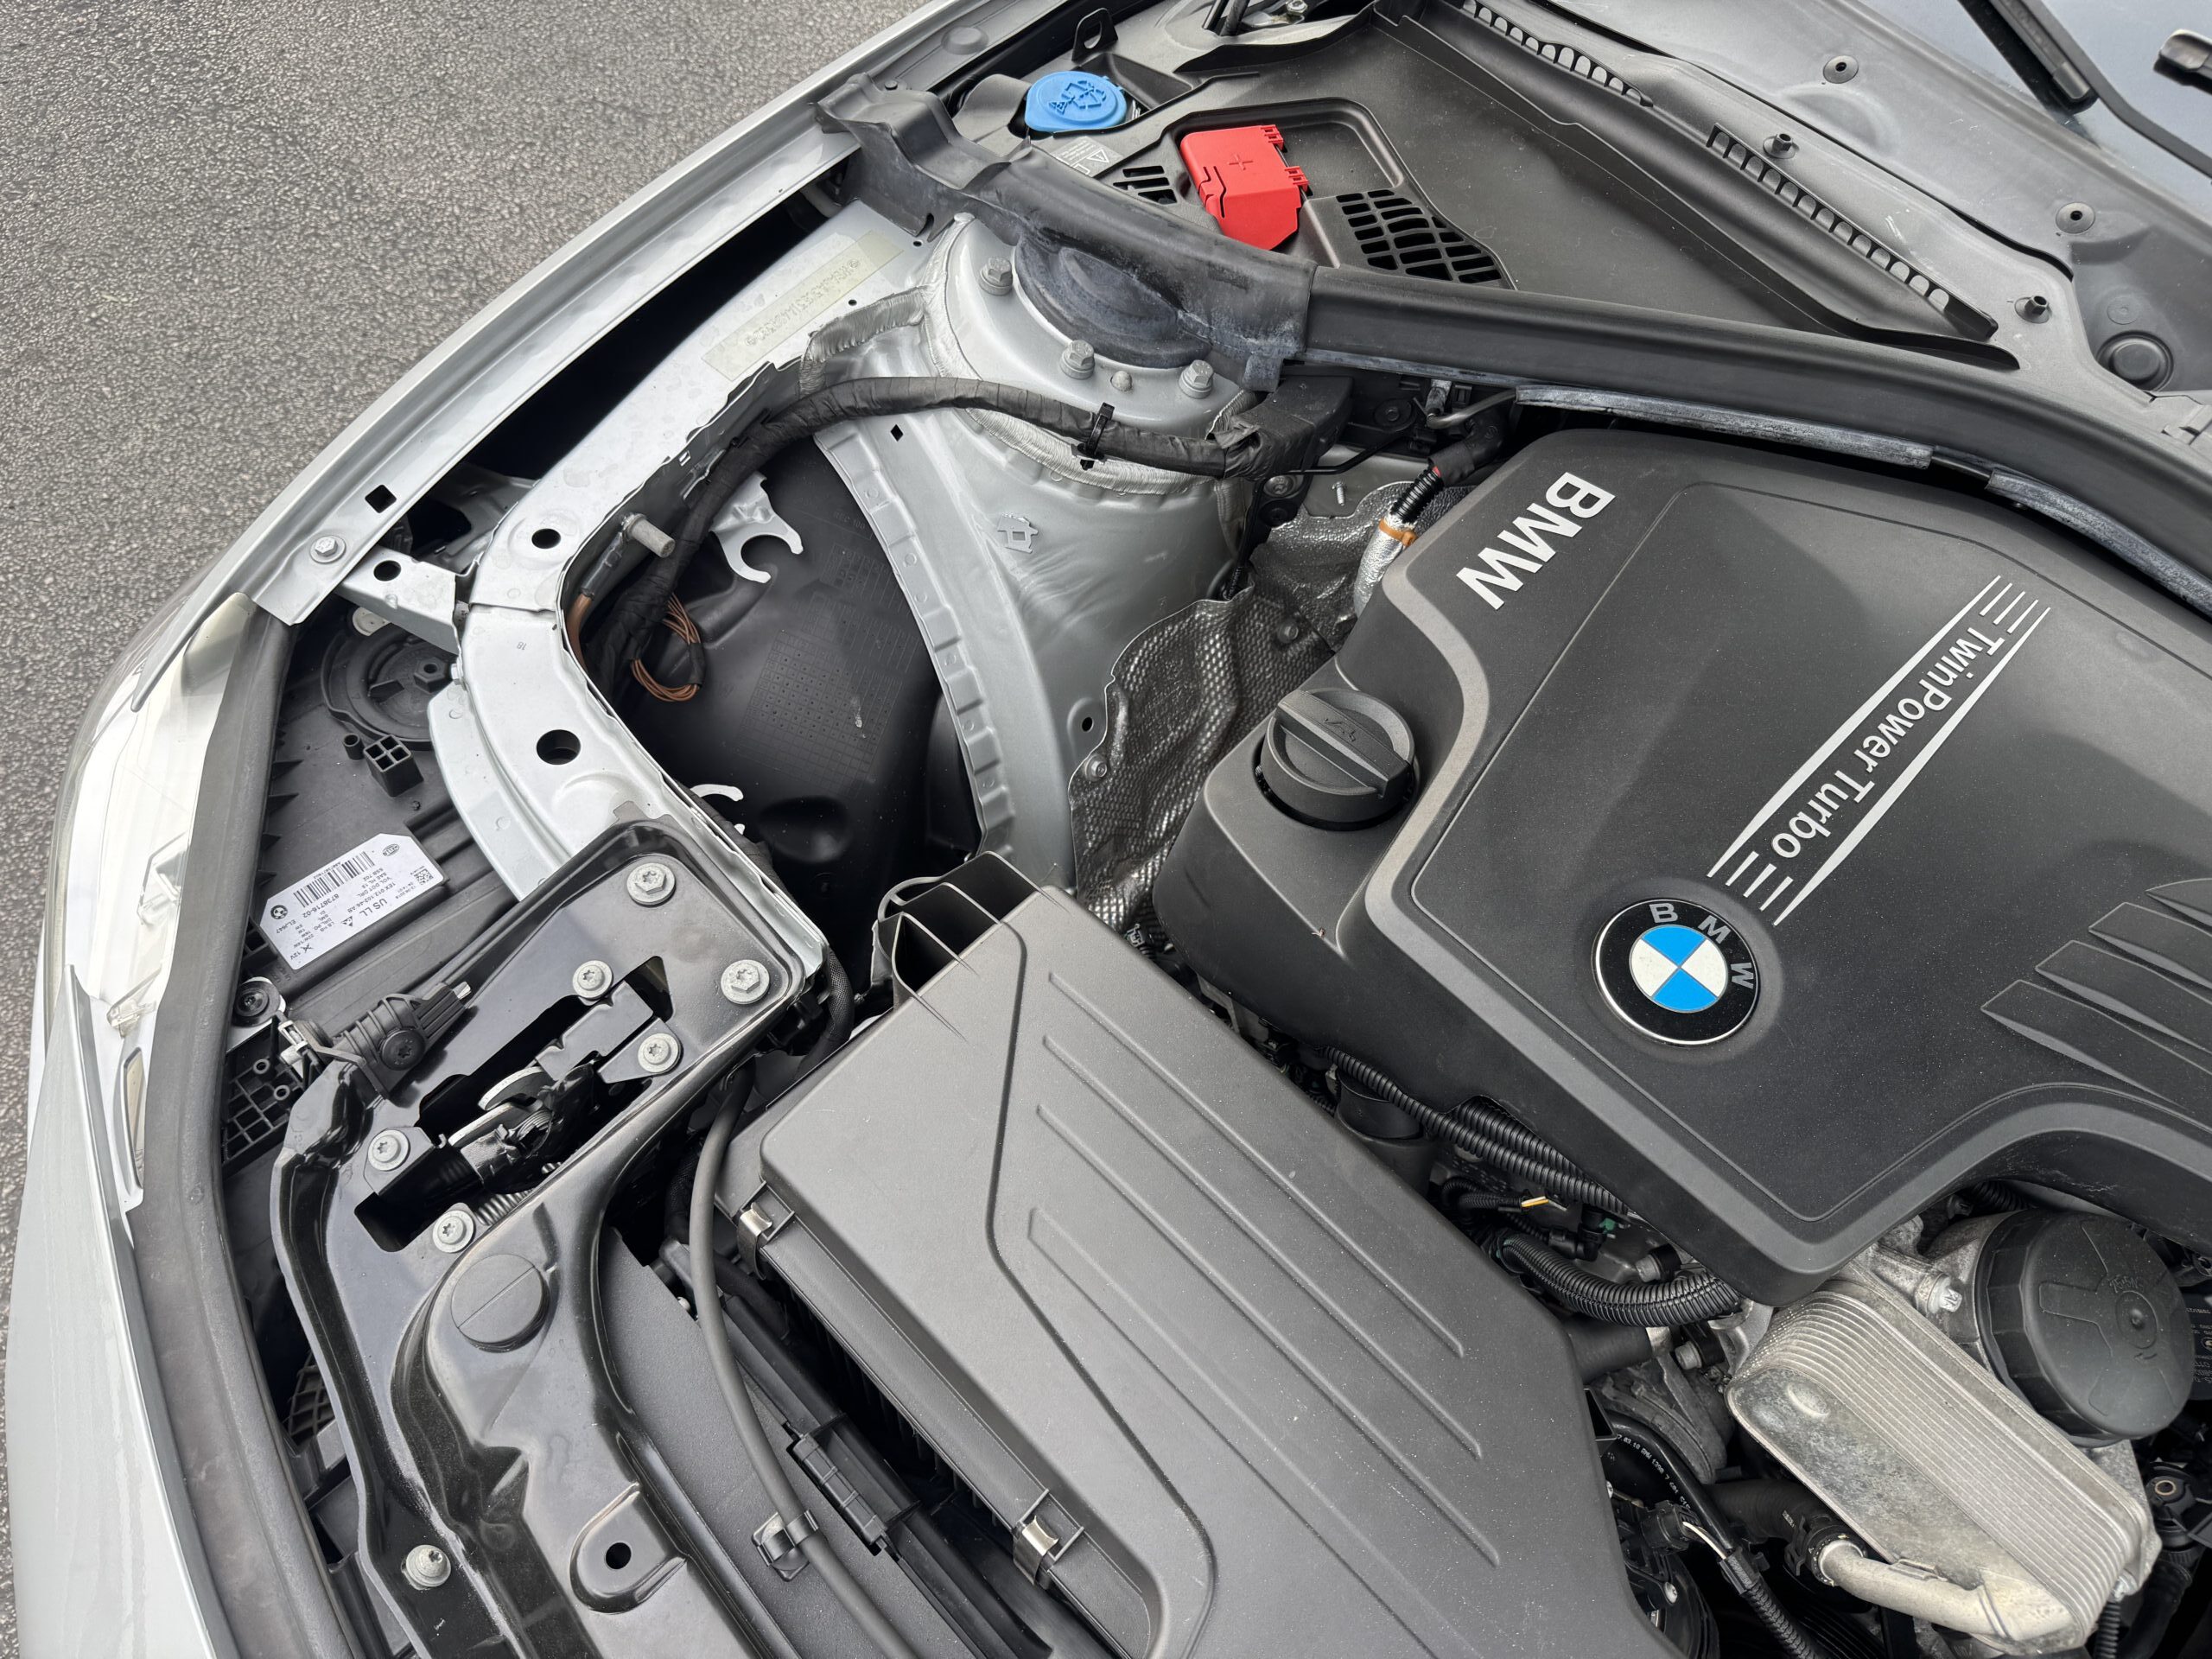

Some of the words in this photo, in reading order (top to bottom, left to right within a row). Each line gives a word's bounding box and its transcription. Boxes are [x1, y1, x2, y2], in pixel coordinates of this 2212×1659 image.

[1456, 472, 1616, 610] BMW
[372, 898, 388, 910] US
[359, 906, 373, 917] LL
[1649, 902, 1754, 989] BMW
[289, 950, 301, 960] 12V
